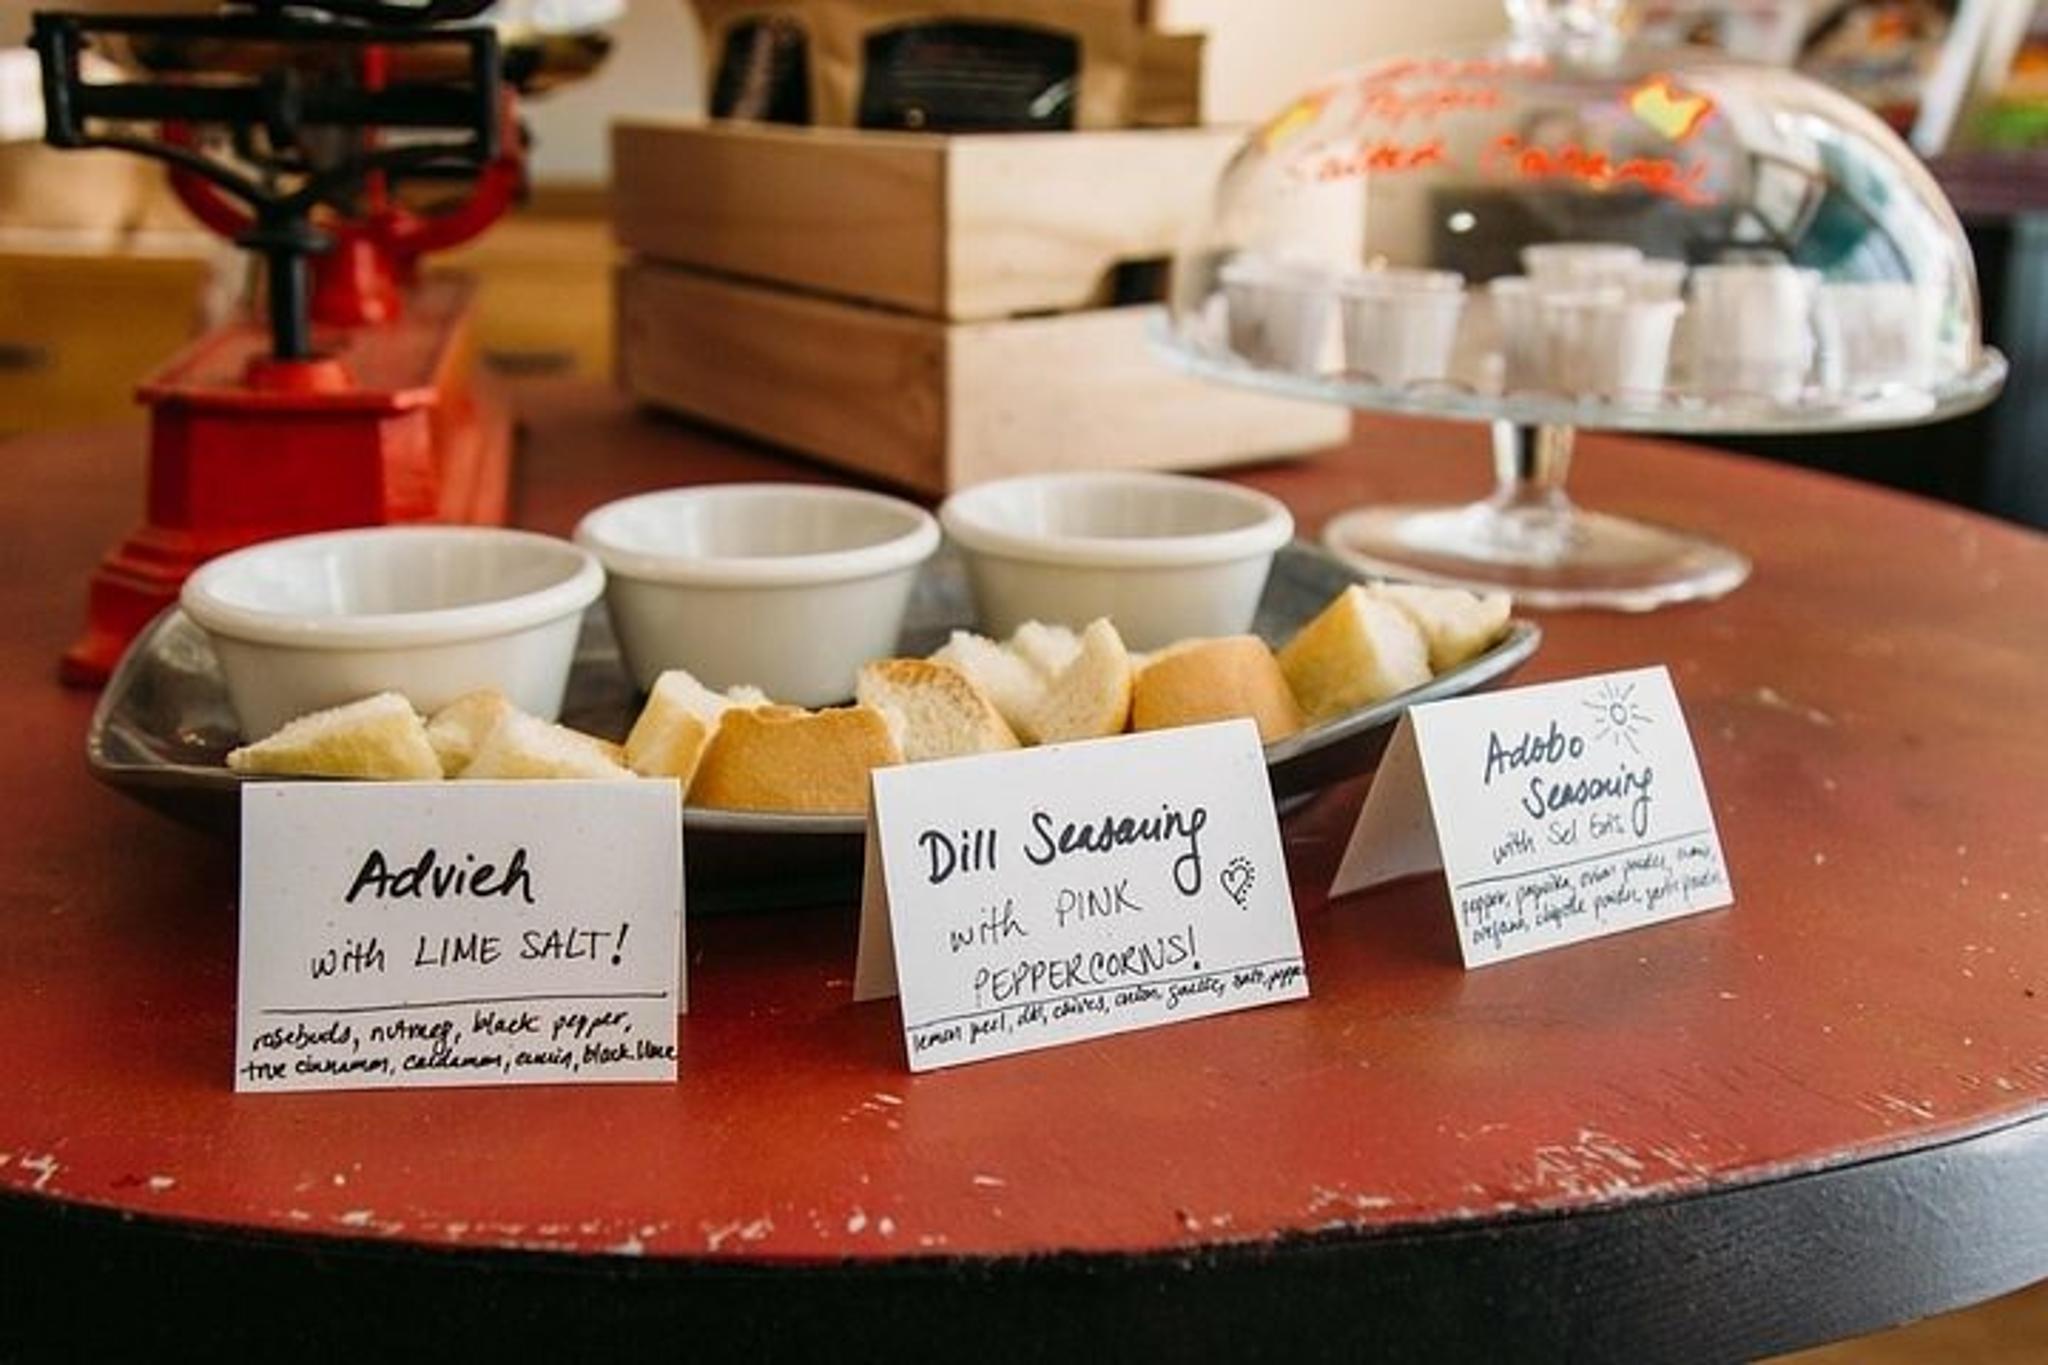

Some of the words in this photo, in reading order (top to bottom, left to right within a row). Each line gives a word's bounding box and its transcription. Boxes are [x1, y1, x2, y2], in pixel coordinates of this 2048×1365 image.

[1484, 720, 1585, 785] Adobo
[1523, 763, 1653, 837] Seasoning
[344, 847, 535, 903] Advieh
[918, 829, 998, 884] Dill
[1023, 804, 1207, 896] Seasoning
[1493, 829, 1535, 865] with
[950, 898, 1029, 952] with
[1056, 879, 1142, 927] PINK
[311, 938, 385, 979] with
[414, 933, 501, 967] LIME
[520, 923, 630, 966] SALT!
[974, 925, 1201, 1008] PEPPERCORNS!
[253, 1021, 360, 1053] rosebuds,
[370, 1019, 461, 1056] nutmeg,
[472, 1010, 540, 1035] black
[551, 1011, 632, 1041] pepper,
[241, 1060, 287, 1081] true
